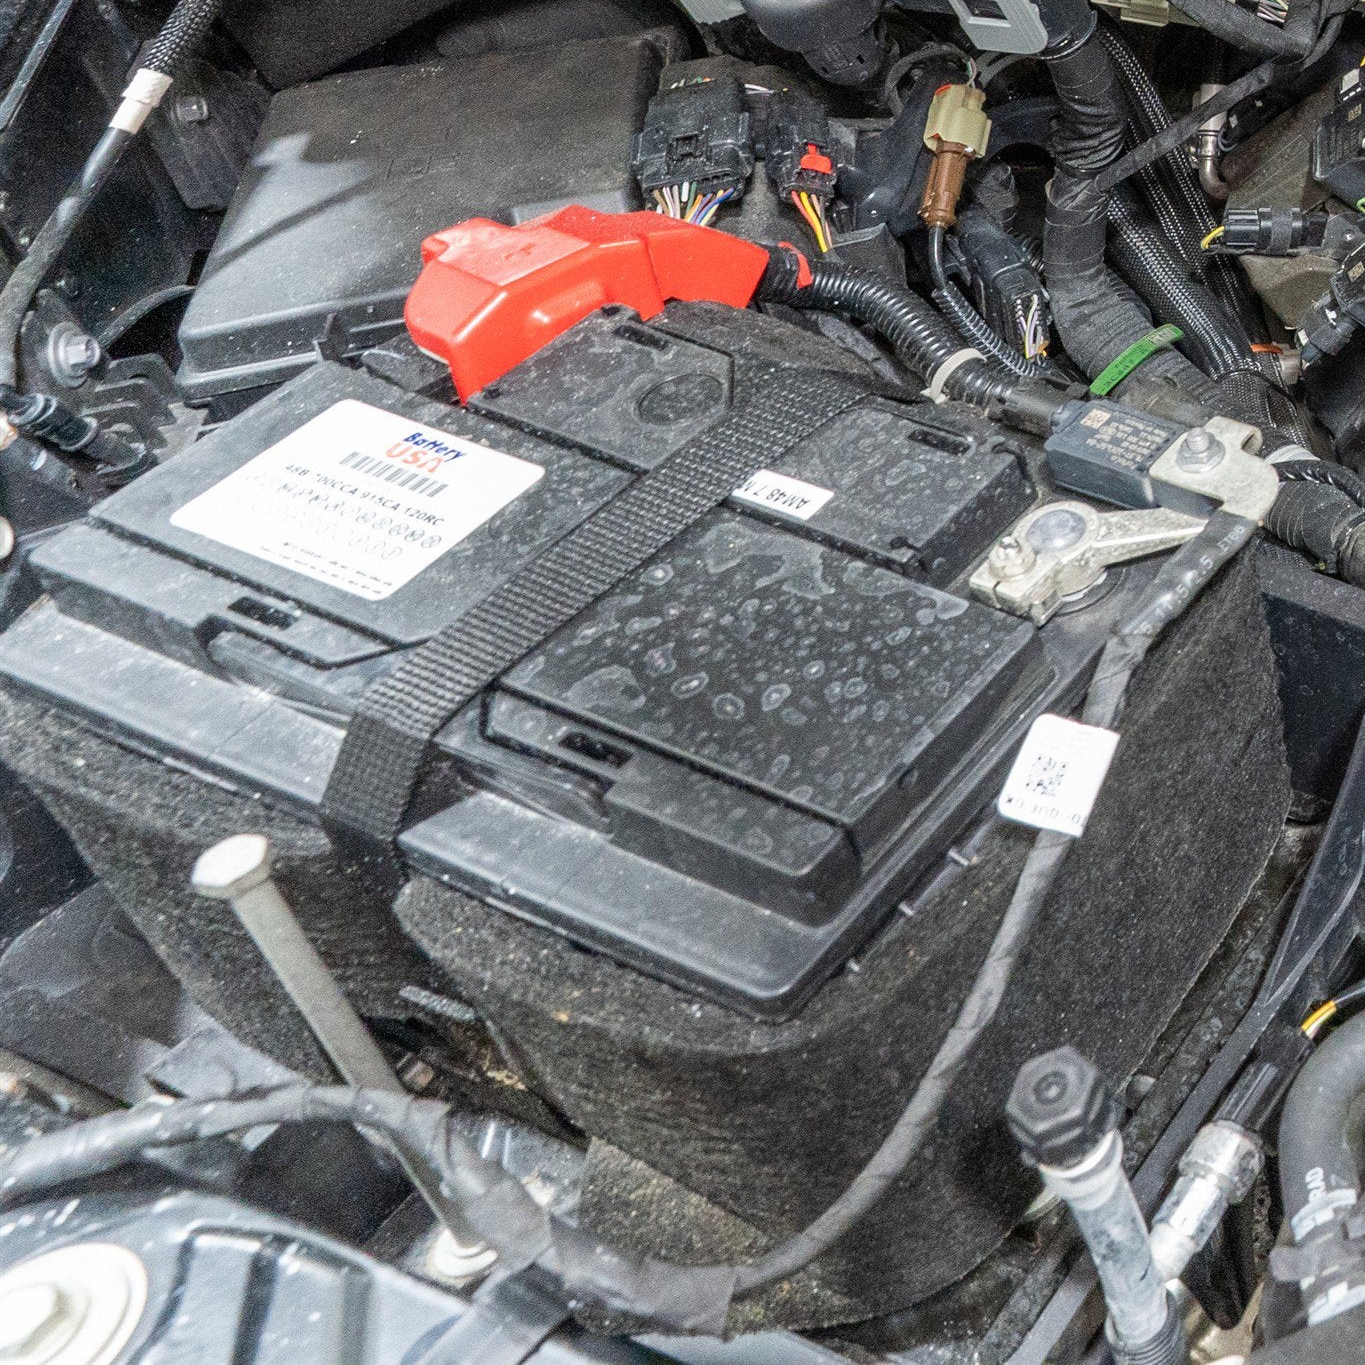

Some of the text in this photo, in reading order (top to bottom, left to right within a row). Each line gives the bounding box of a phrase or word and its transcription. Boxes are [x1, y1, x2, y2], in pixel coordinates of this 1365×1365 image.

[385, 442, 445, 473] USA
[403, 432, 466, 463] Battery
[766, 489, 811, 510] AM48
[403, 506, 445, 527] 120RC
